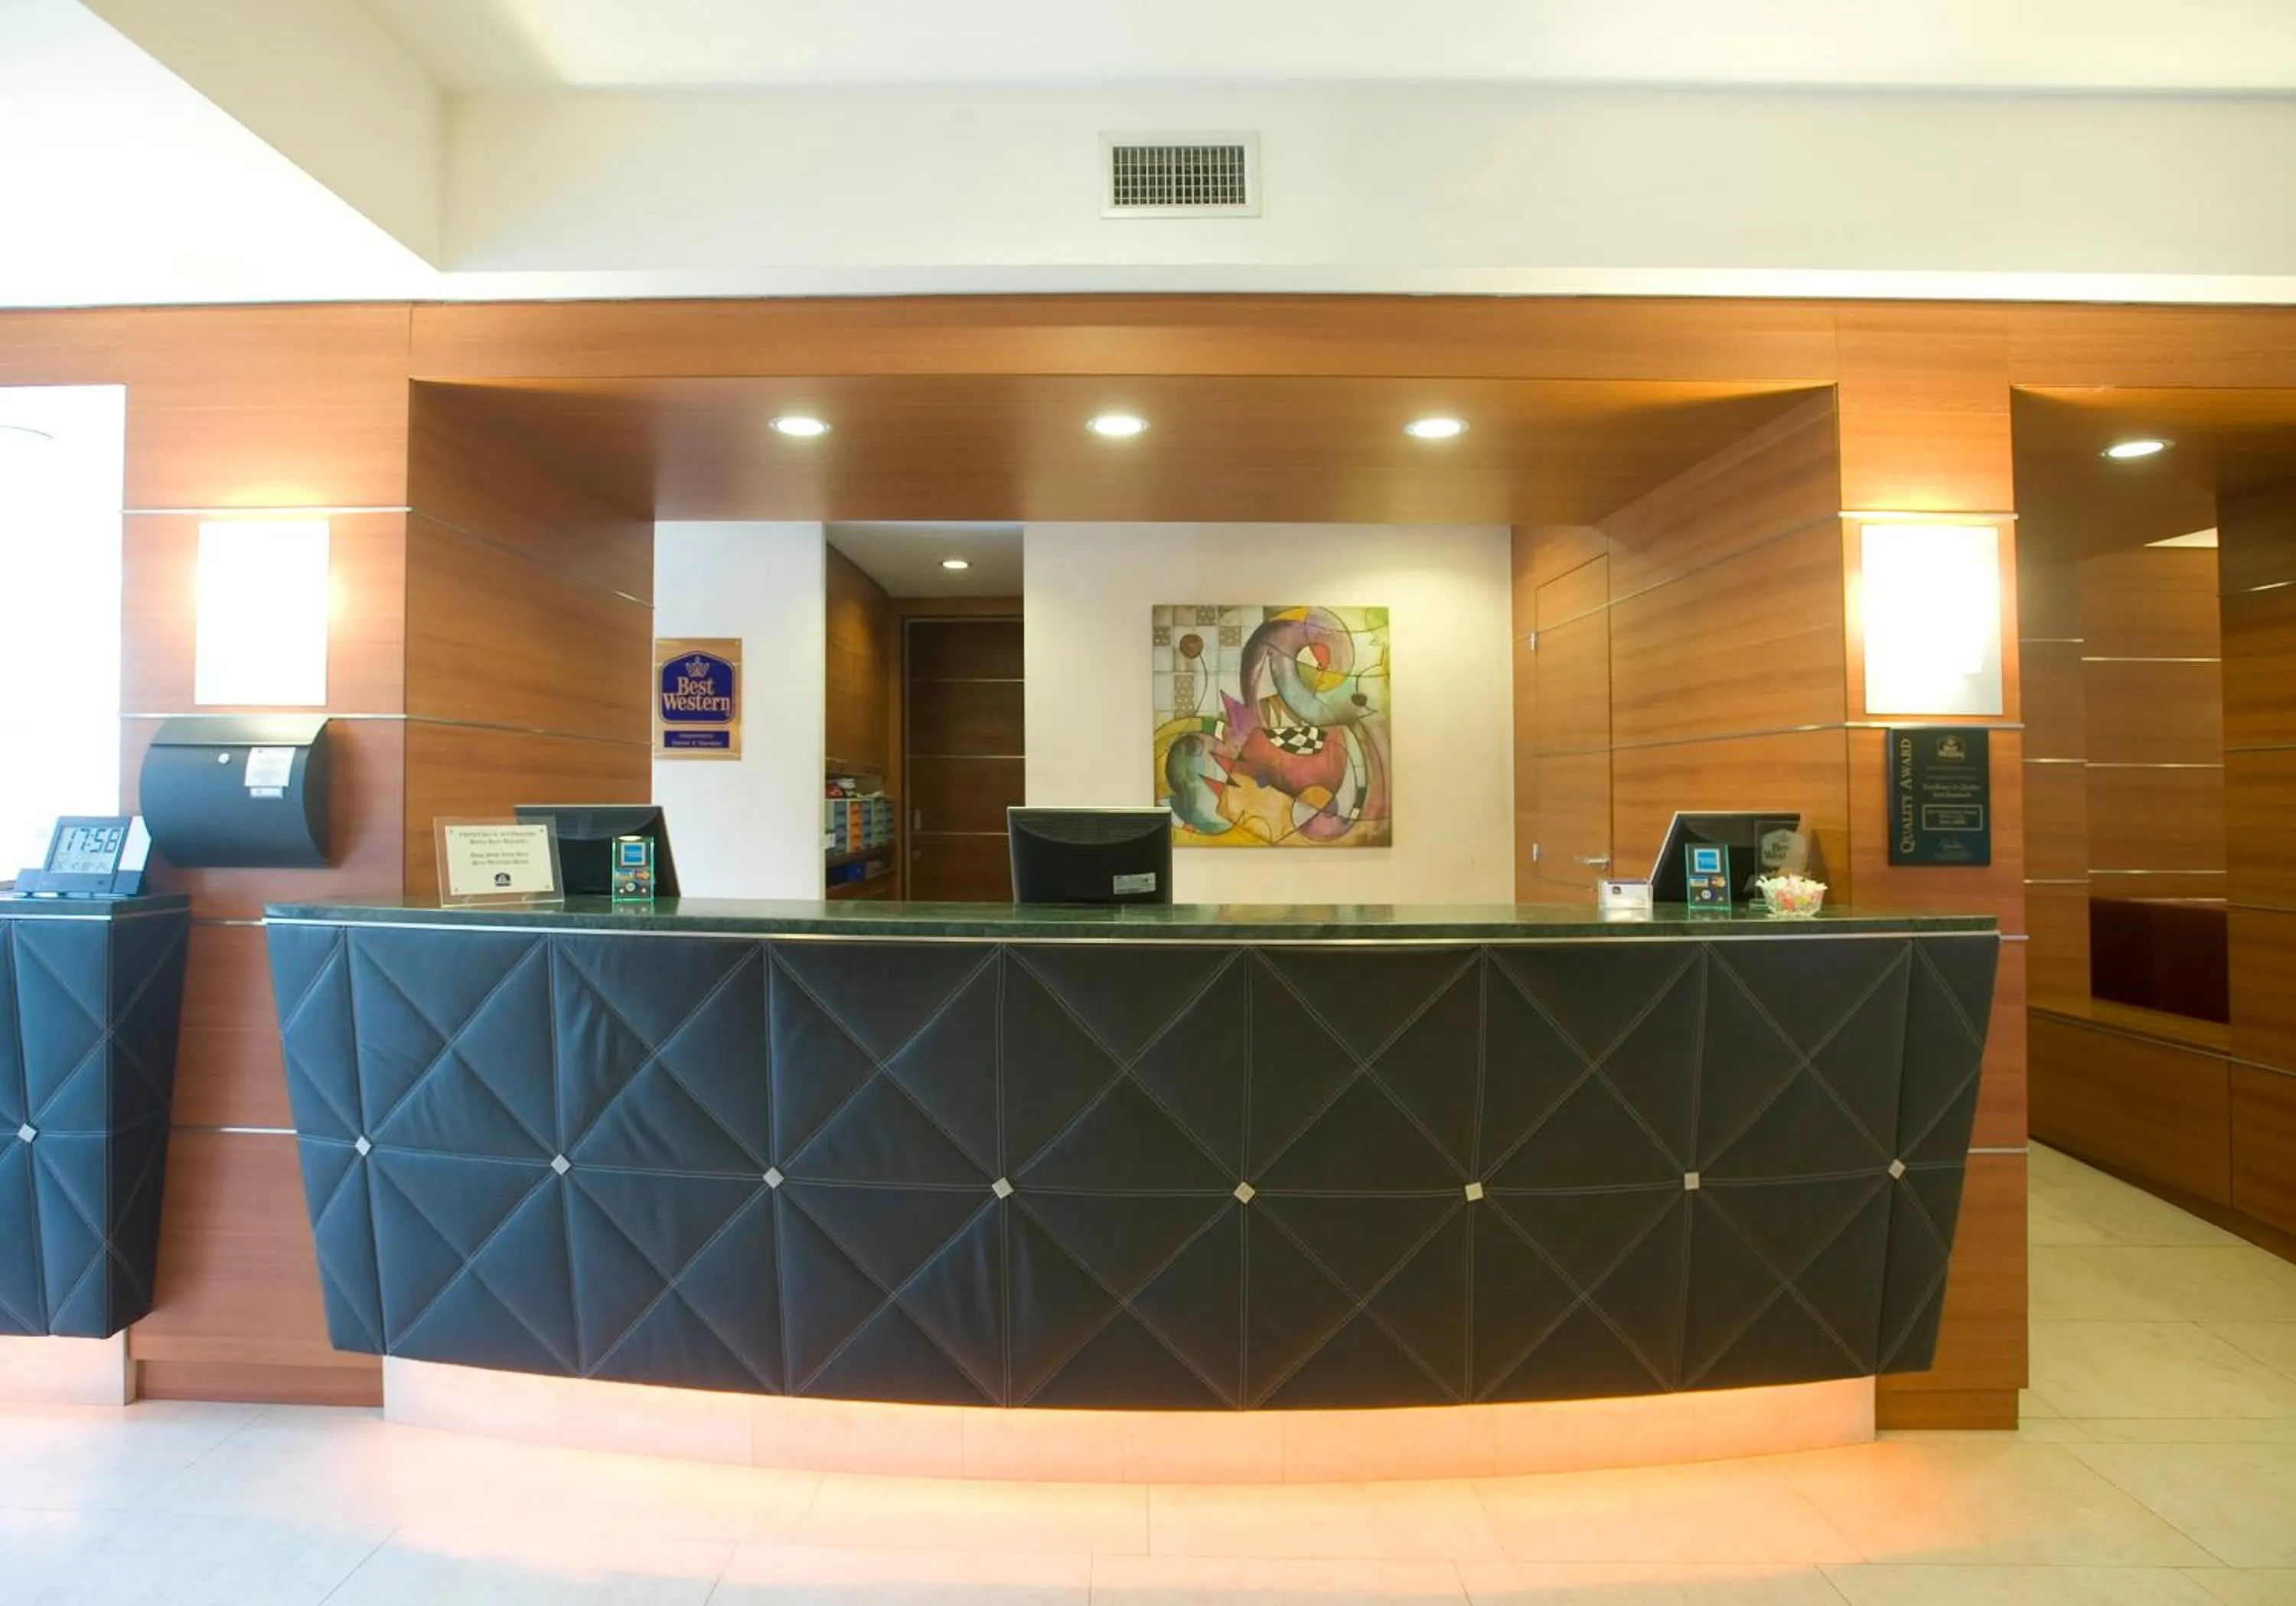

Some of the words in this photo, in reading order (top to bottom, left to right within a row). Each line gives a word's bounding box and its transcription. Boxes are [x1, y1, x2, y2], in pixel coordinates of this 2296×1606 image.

[677, 677, 715, 695] Best
[663, 693, 730, 711] Western
[1900, 738, 1913, 790] AWARD
[1900, 794, 1915, 854] QUALITY
[67, 828, 120, 853] 17:58
